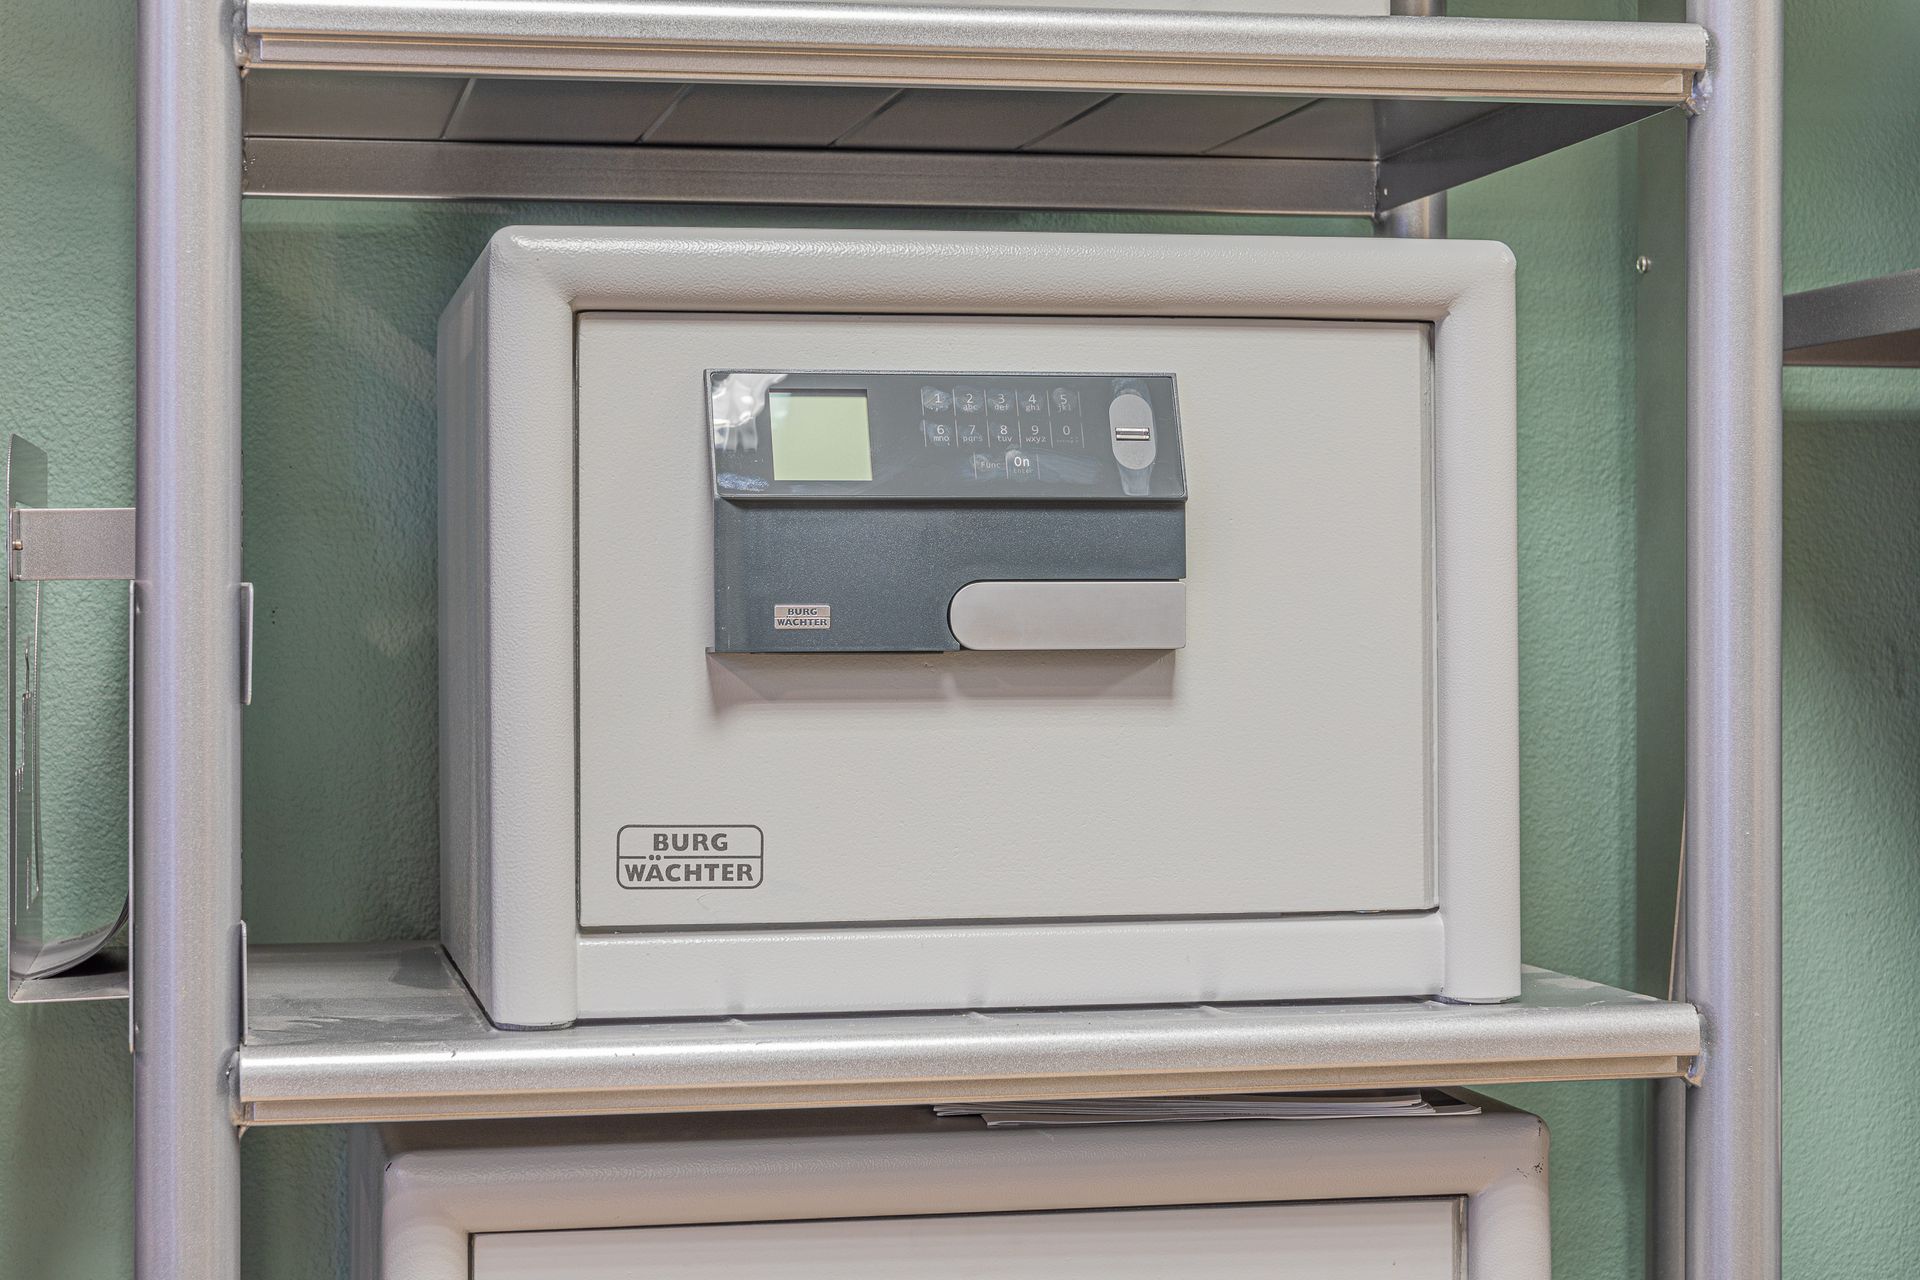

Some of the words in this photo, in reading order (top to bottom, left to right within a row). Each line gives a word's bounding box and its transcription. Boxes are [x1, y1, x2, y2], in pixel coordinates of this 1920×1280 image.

[934, 393, 942, 404] 1
[965, 393, 974, 404] 2
[998, 393, 1006, 404] 3
[1028, 393, 1037, 404] 4
[1060, 394, 1068, 405] 5
[936, 424, 945, 435] 6
[968, 424, 976, 435] 7
[1000, 424, 1008, 435] 8
[1031, 424, 1040, 435] 9
[980, 461, 1001, 469] Func
[1014, 456, 1030, 467] On
[787, 608, 818, 616] BURG
[776, 615, 828, 626] WÄCHTER
[653, 833, 728, 852] BURG
[624, 854, 754, 882] WÄCHTER
